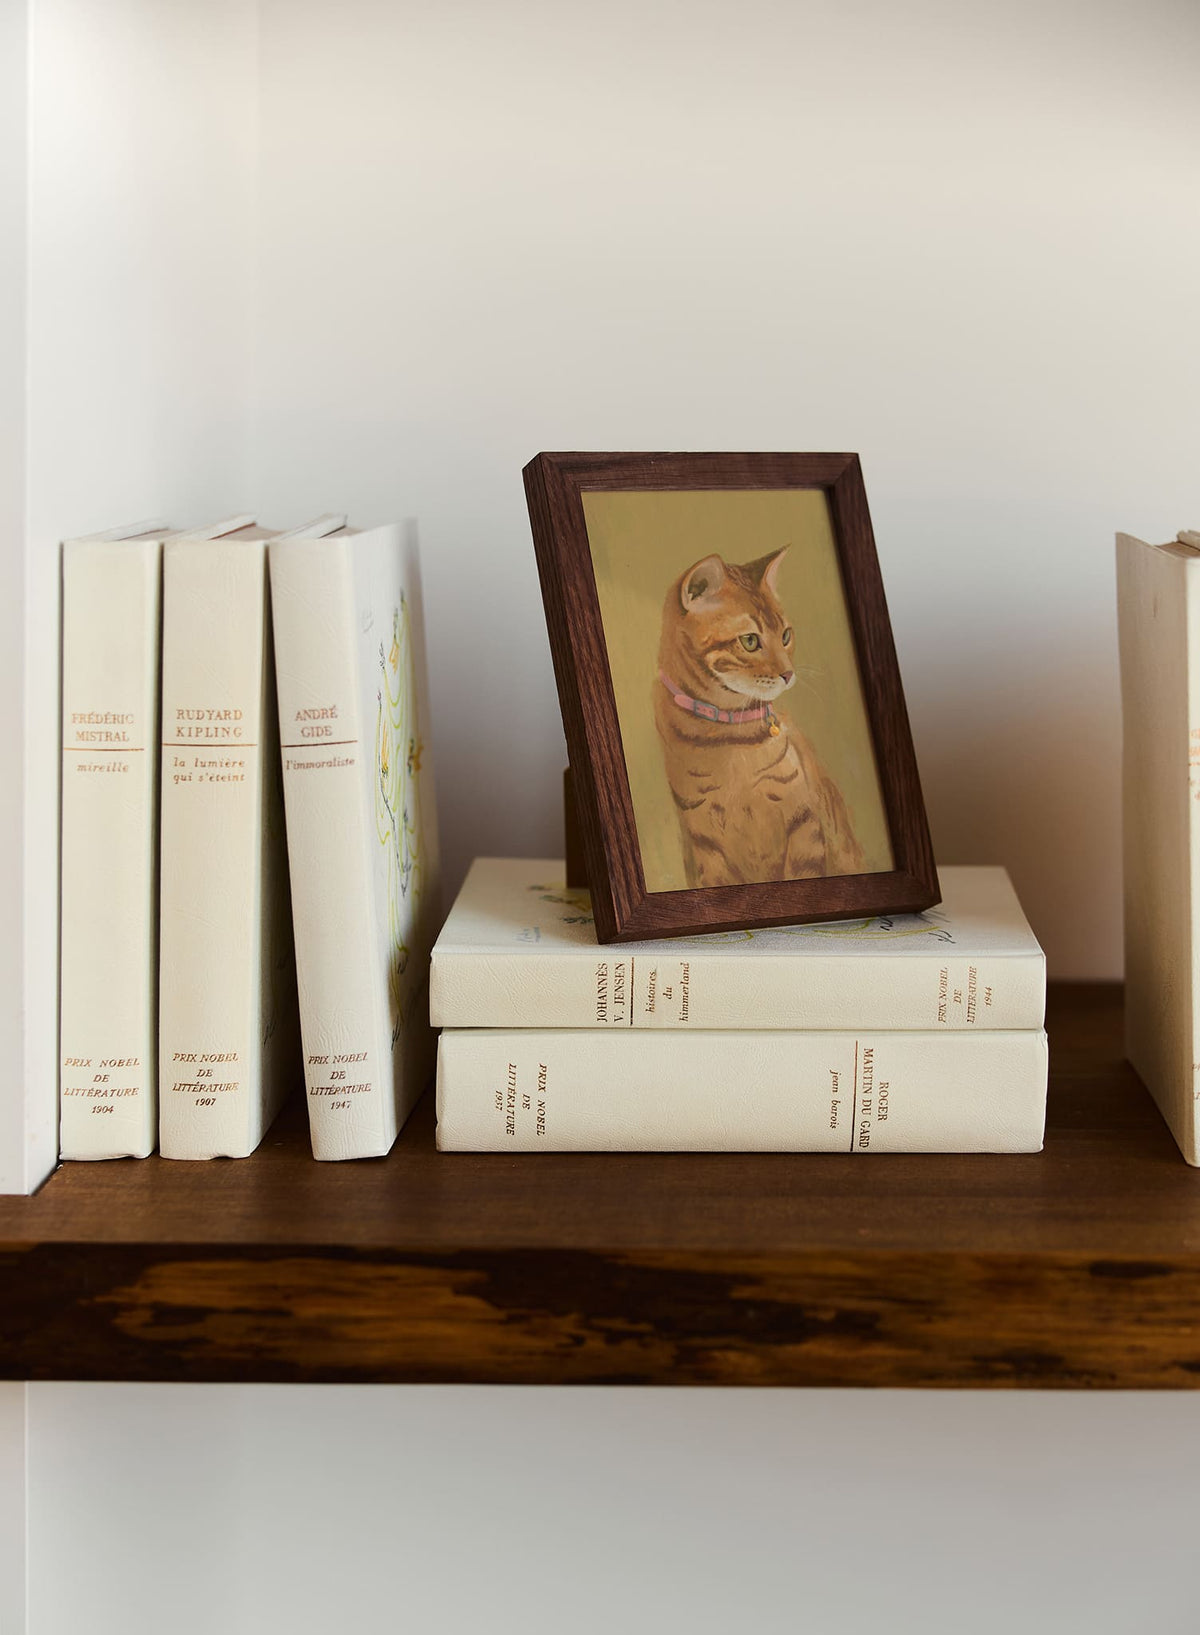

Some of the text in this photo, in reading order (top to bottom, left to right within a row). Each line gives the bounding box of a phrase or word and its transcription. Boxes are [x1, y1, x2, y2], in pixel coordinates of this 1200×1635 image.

[72, 712, 134, 725] FRÉDÉRIC
[176, 709, 243, 721] RUDYARD
[295, 705, 338, 722] ANDRÉ
[76, 730, 130, 742] MISTRAL
[176, 726, 243, 738] KIPLING
[301, 725, 333, 738] GIDE
[77, 761, 129, 773] mireille
[174, 757, 245, 767] la lumière
[286, 757, 356, 771] l'immoraliste
[173, 772, 193, 784] qui
[614, 962, 625, 1022] V. JENSEN
[645, 971, 656, 1013] histoires
[663, 986, 673, 1000] du
[679, 962, 690, 1022] himmerland
[938, 967, 948, 1023] PRIX NOBEL
[953, 989, 962, 1004] DE
[984, 986, 992, 1007] 1944
[64, 1057, 140, 1068] PRIX NOBEL
[172, 1052, 239, 1063] PRIX NOBEL
[308, 1052, 368, 1065] PRIX NOBEL
[93, 1074, 109, 1083] DE
[196, 1068, 213, 1078] DE
[330, 1070, 346, 1080] DE
[64, 1086, 138, 1098] LITTÉRATURE
[172, 1081, 240, 1093] LITTÉRATURE
[309, 1082, 372, 1096] LITTÉRATURE
[195, 1097, 217, 1107] 1907
[495, 1090, 503, 1111] 1937
[506, 1063, 517, 1136] LITTÉRATURE
[522, 1094, 531, 1110] DE
[536, 1063, 547, 1136] PRIX NOBEL
[829, 1069, 841, 1129] jean barois
[859, 1048, 874, 1148] MARTIN DU GARD
[878, 1082, 889, 1121] ROGER
[91, 1105, 115, 1114] 1904
[330, 1100, 352, 1110] 1947
